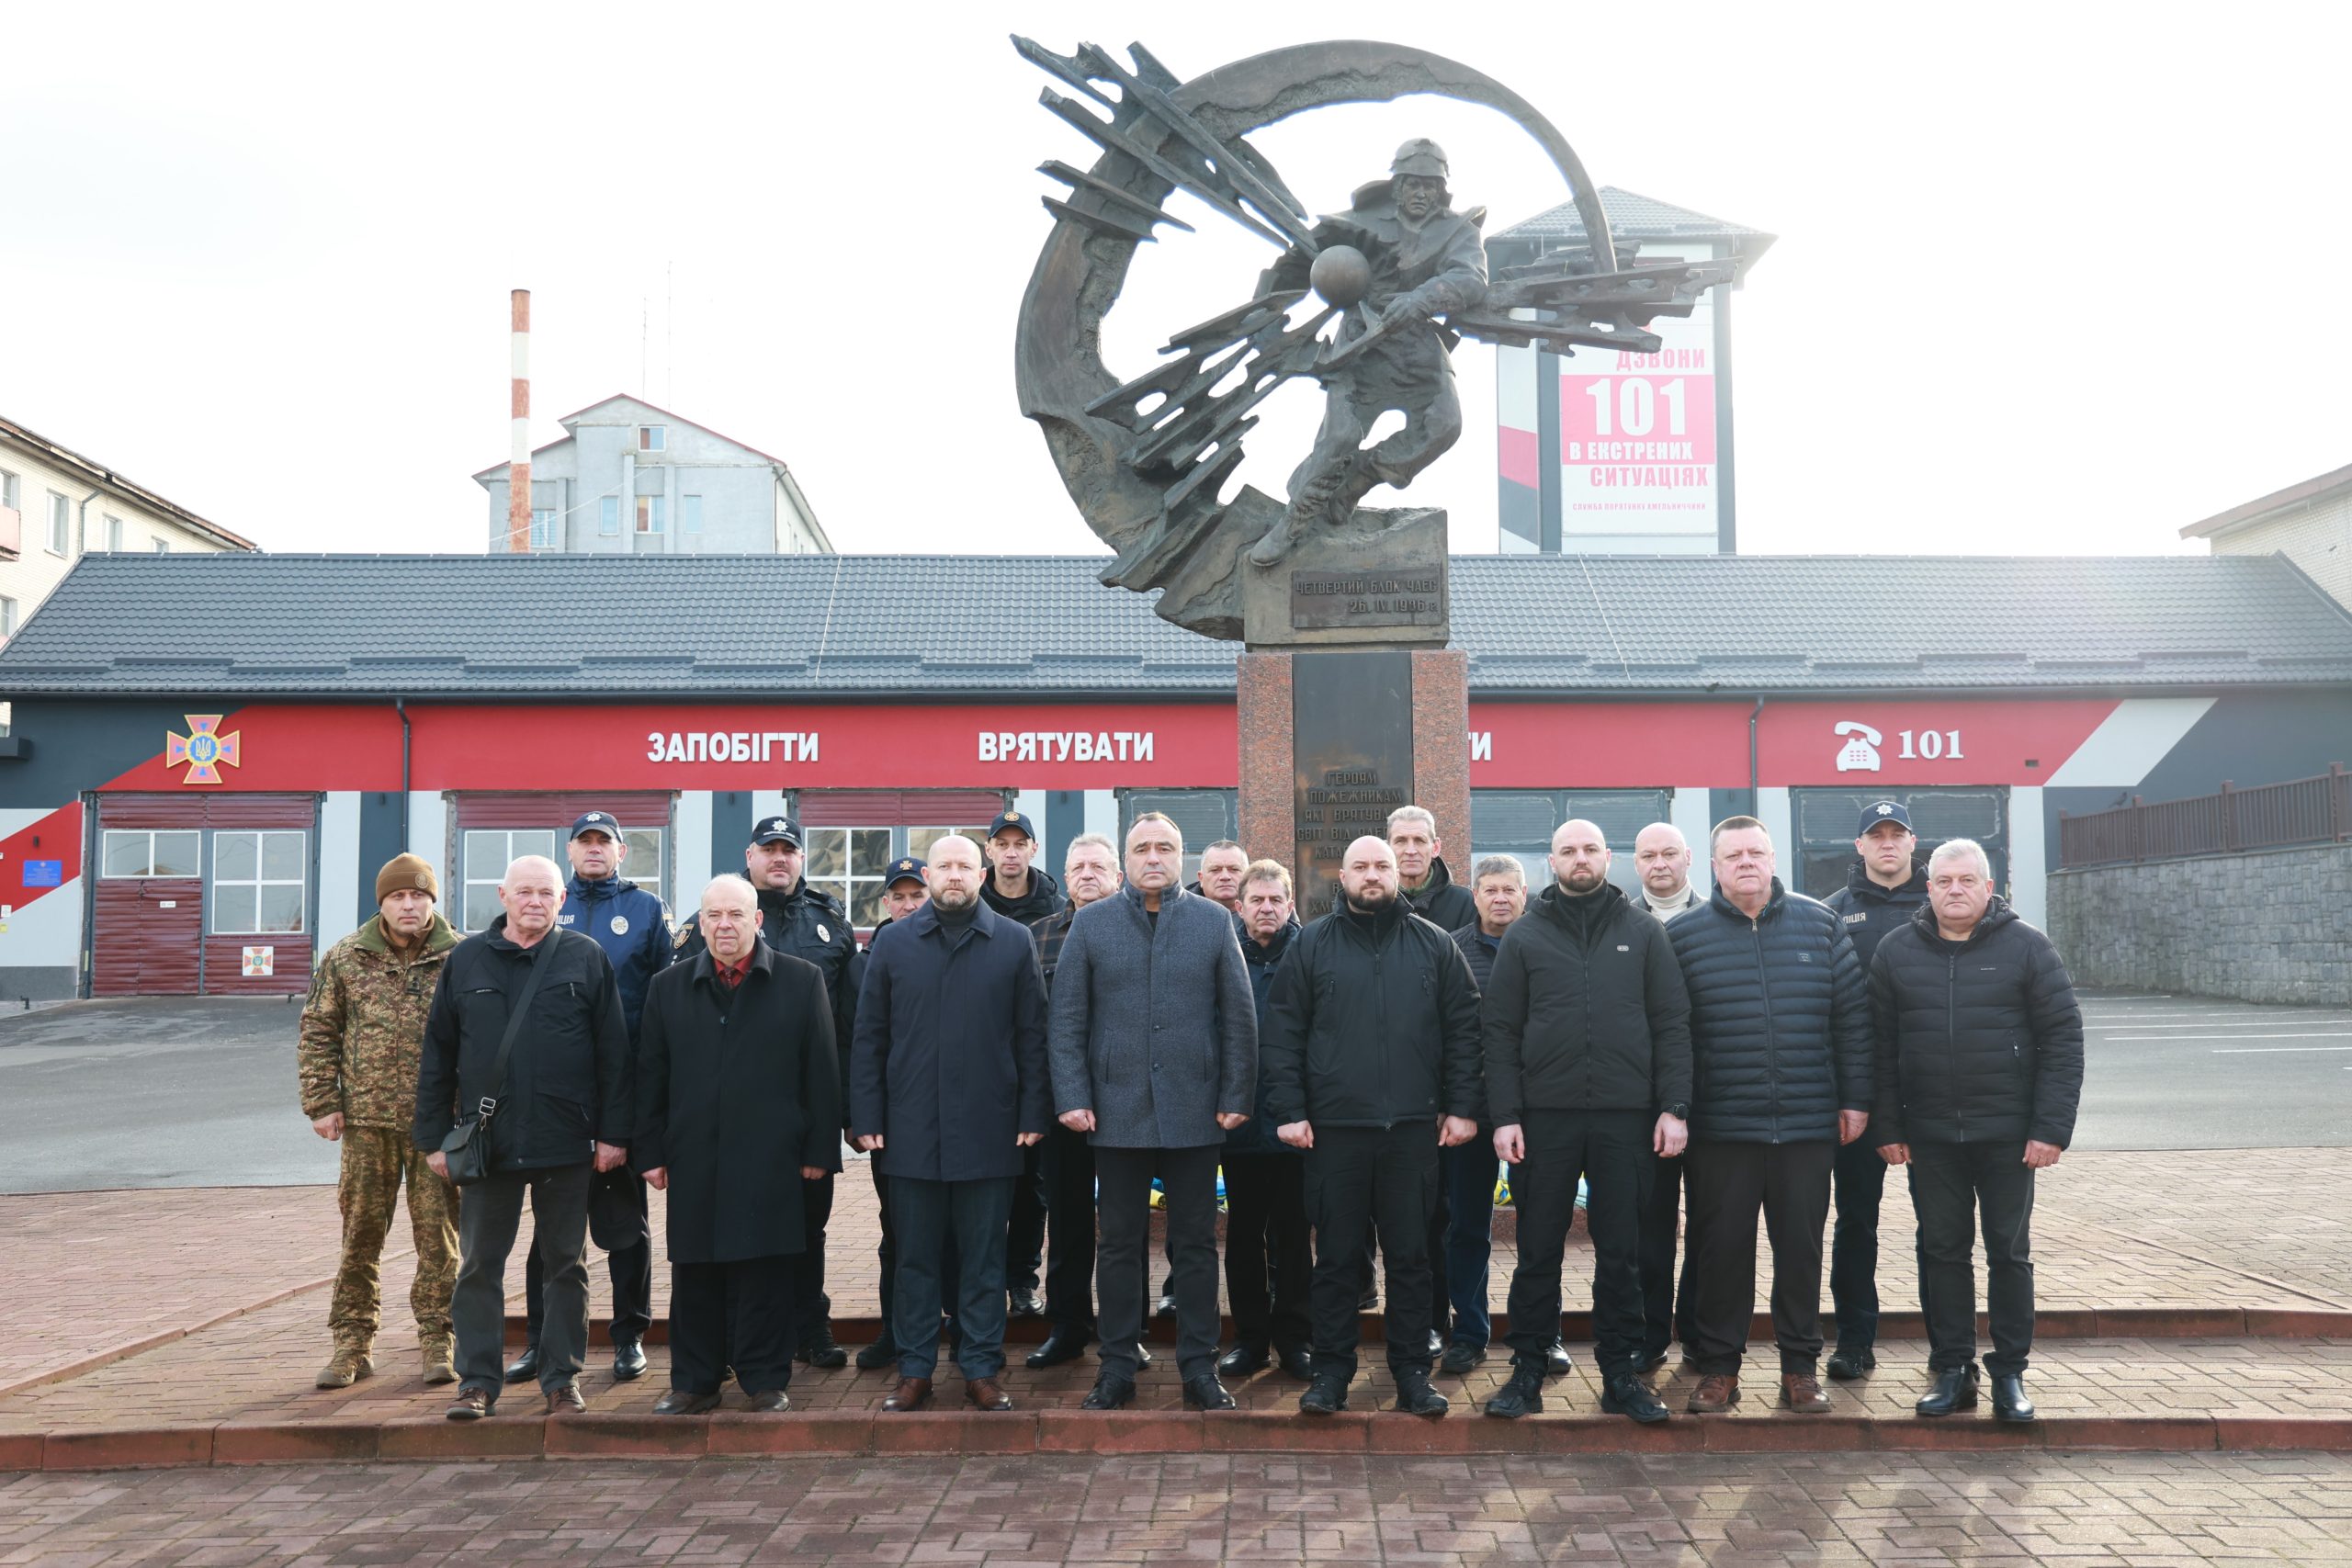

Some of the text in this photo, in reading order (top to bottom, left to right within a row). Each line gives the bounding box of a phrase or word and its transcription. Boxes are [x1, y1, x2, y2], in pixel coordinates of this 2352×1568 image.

[1617, 348, 1705, 371] ДЗВОНИ
[1586, 377, 1686, 436] 101
[1569, 442, 1693, 460] В ЕКСТРЕНИХ
[1590, 467, 1709, 489] СИТУАЦІЯХ
[1296, 580, 1437, 594] ЧЕТВЕРТИЙ БЛОК ЧАЕС
[647, 732, 819, 762] ЗАПОБІГТИ
[978, 732, 1154, 761] ВРЯТУВАТИ
[1898, 730, 1964, 759] 101
[1327, 773, 1376, 784] ГЕРОЯМ
[1310, 791, 1402, 804] ПОЖЕЖНИКАМ
[1305, 808, 1388, 822] ЯКІ ВРЯТУВА
[1296, 829, 1323, 840] СВІТ
[1331, 828, 1351, 840] ВІД
